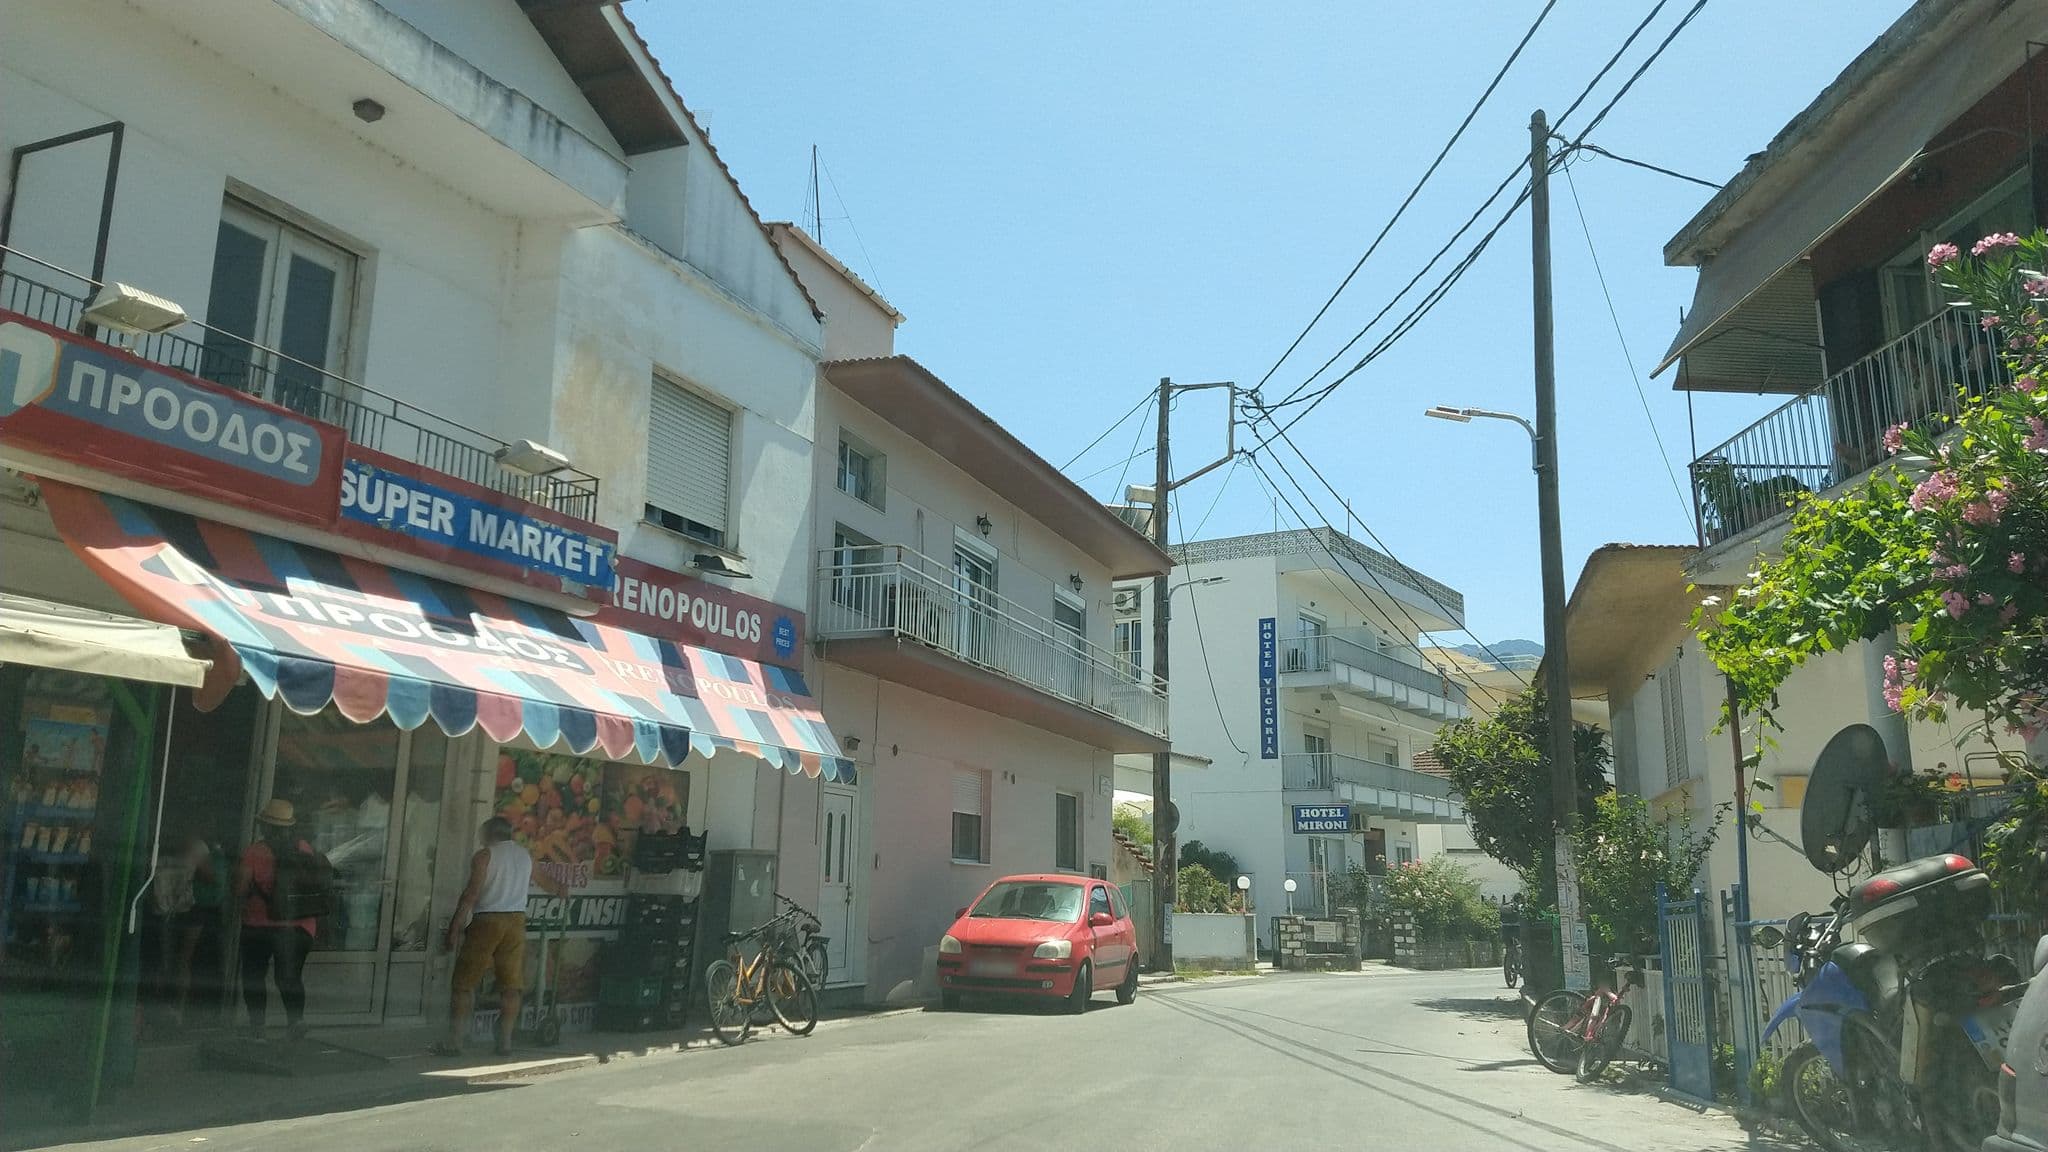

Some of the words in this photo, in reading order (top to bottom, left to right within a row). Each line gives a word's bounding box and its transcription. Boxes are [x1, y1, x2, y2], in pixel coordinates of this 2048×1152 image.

[67, 360, 312, 474] ΠΡΟΟΔΟΣ
[340, 468, 456, 537] SUPER
[469, 508, 603, 577] MARKET
[1263, 622, 1273, 668] HOTEL
[1263, 677, 1275, 754] VICTORIA
[1297, 820, 1348, 831] MIRONI
[1300, 808, 1345, 818] HOTEL
